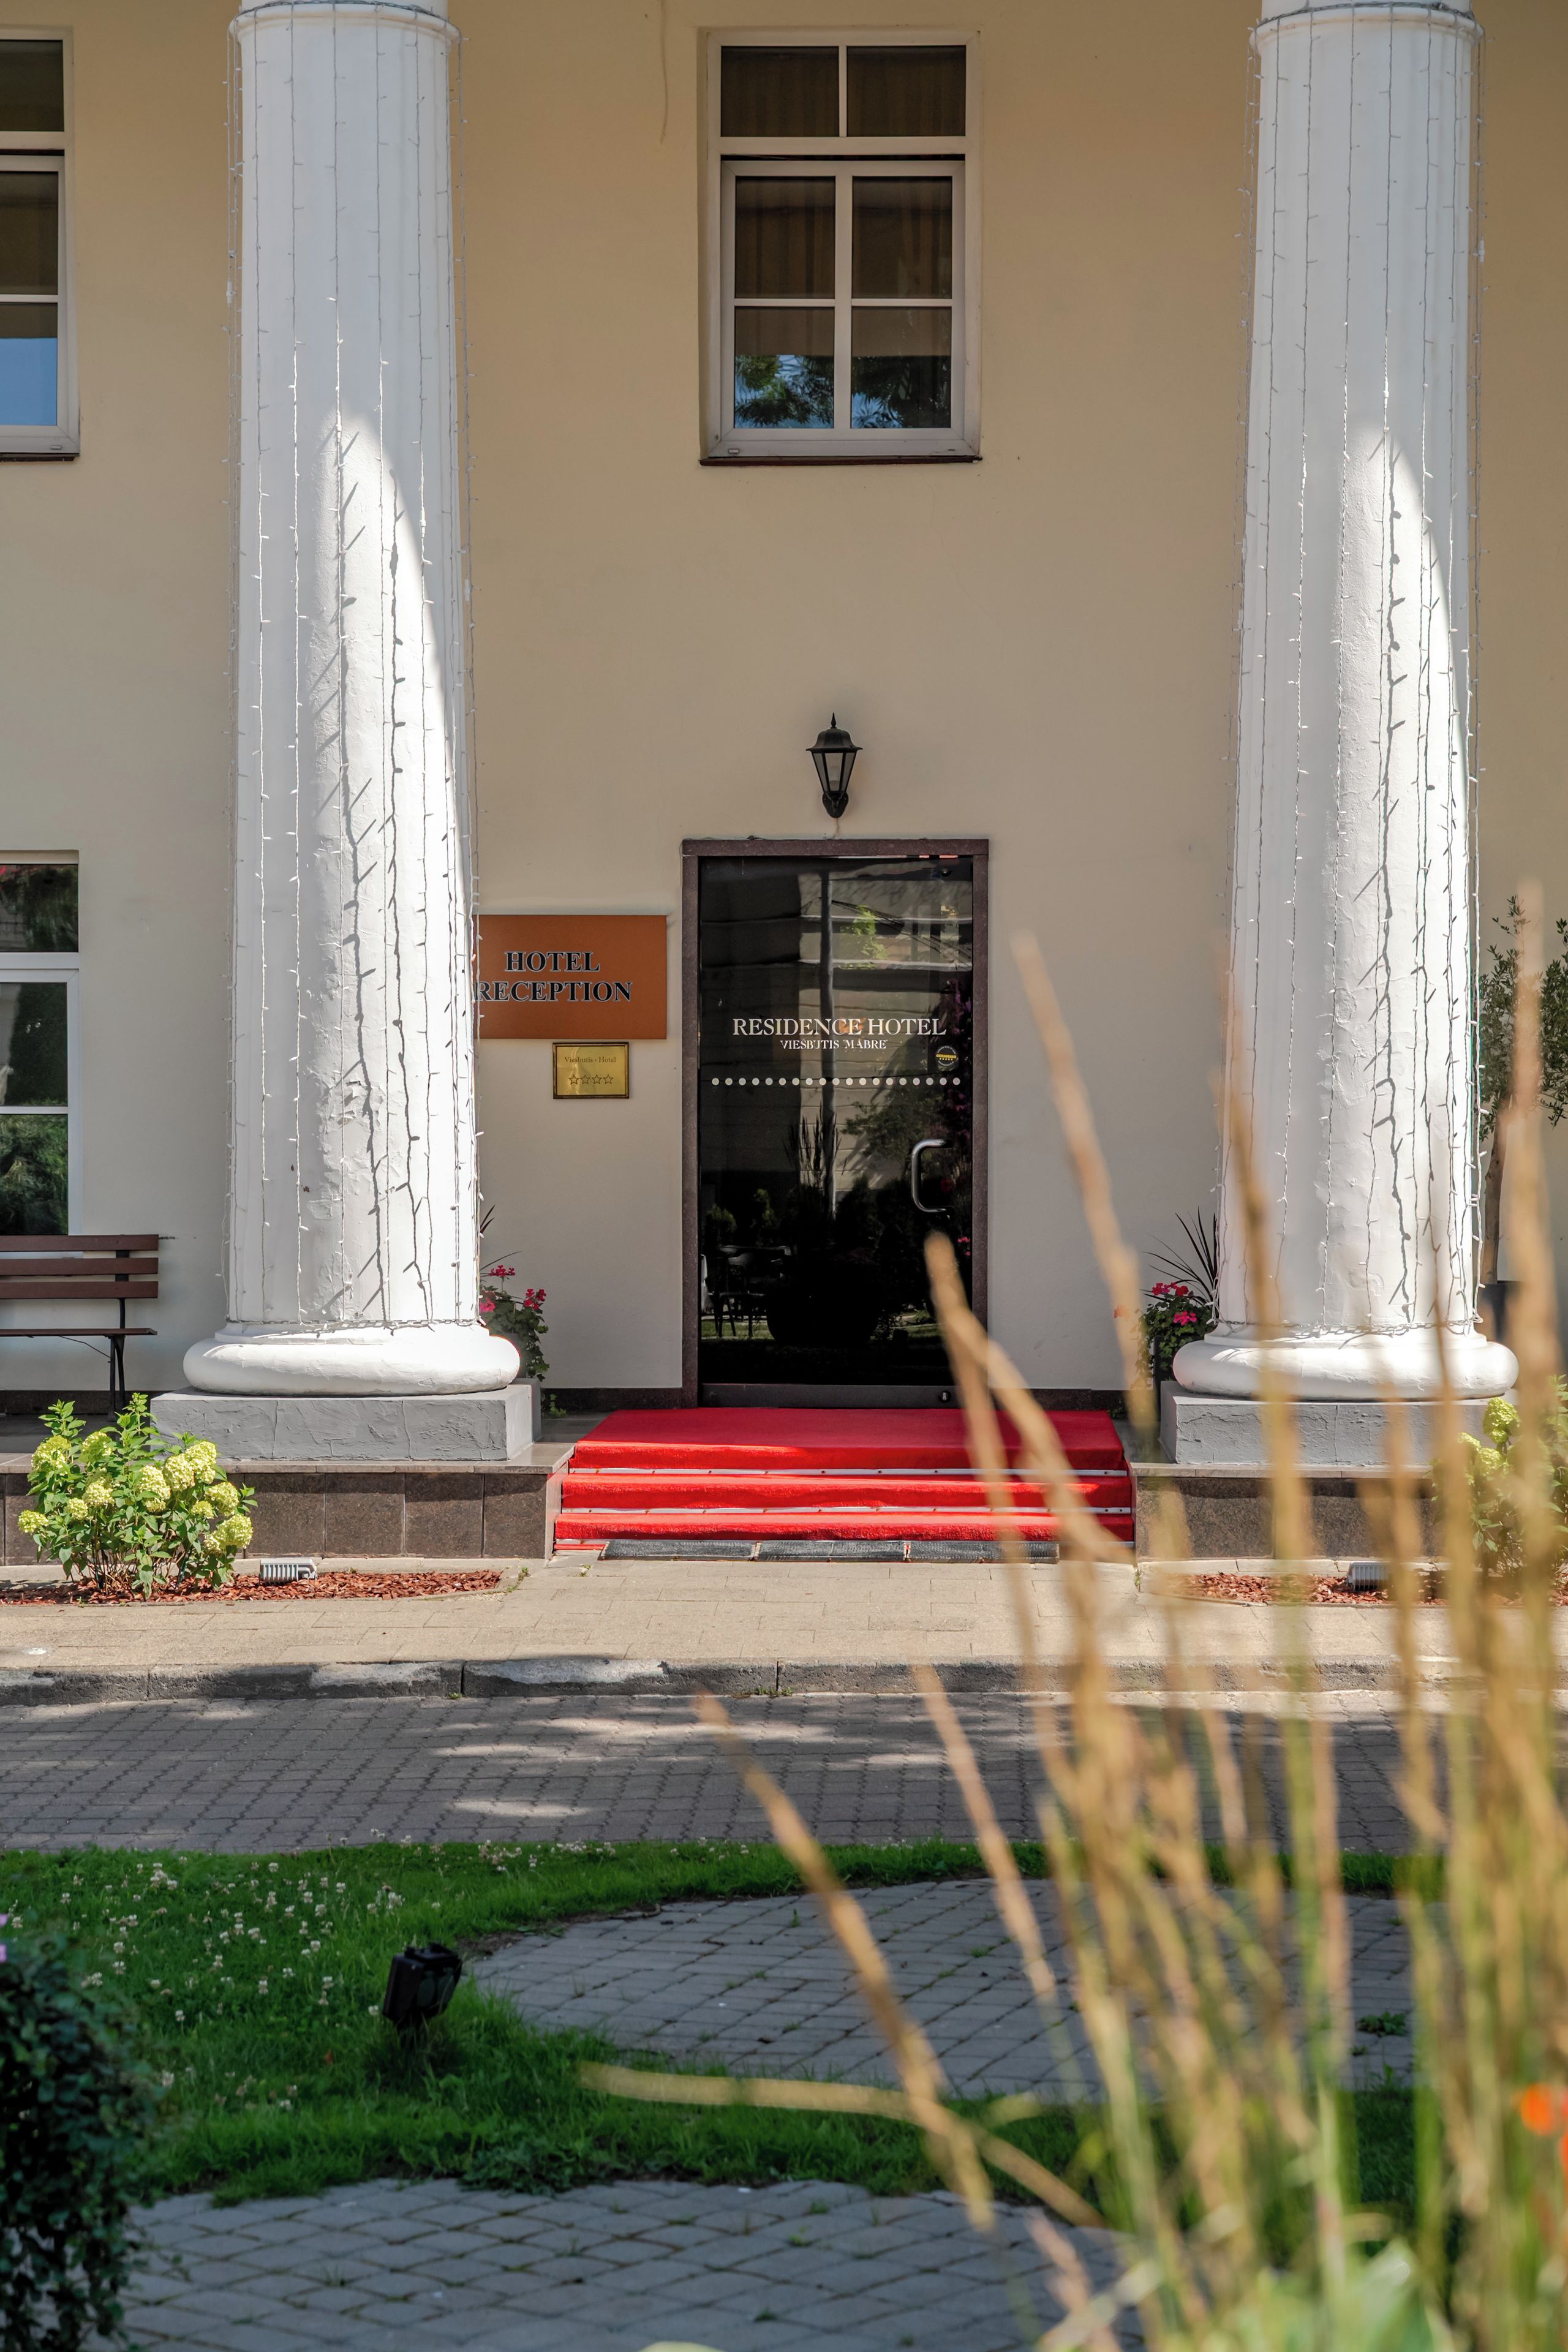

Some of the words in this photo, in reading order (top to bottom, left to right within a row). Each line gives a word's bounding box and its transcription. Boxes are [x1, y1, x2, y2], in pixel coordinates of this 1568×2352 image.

[504, 951, 601, 972] HOTEL
[474, 981, 633, 1001] RECEPTION
[733, 1019, 862, 1035] RESIDENCE
[868, 1019, 947, 1035] HOTEL
